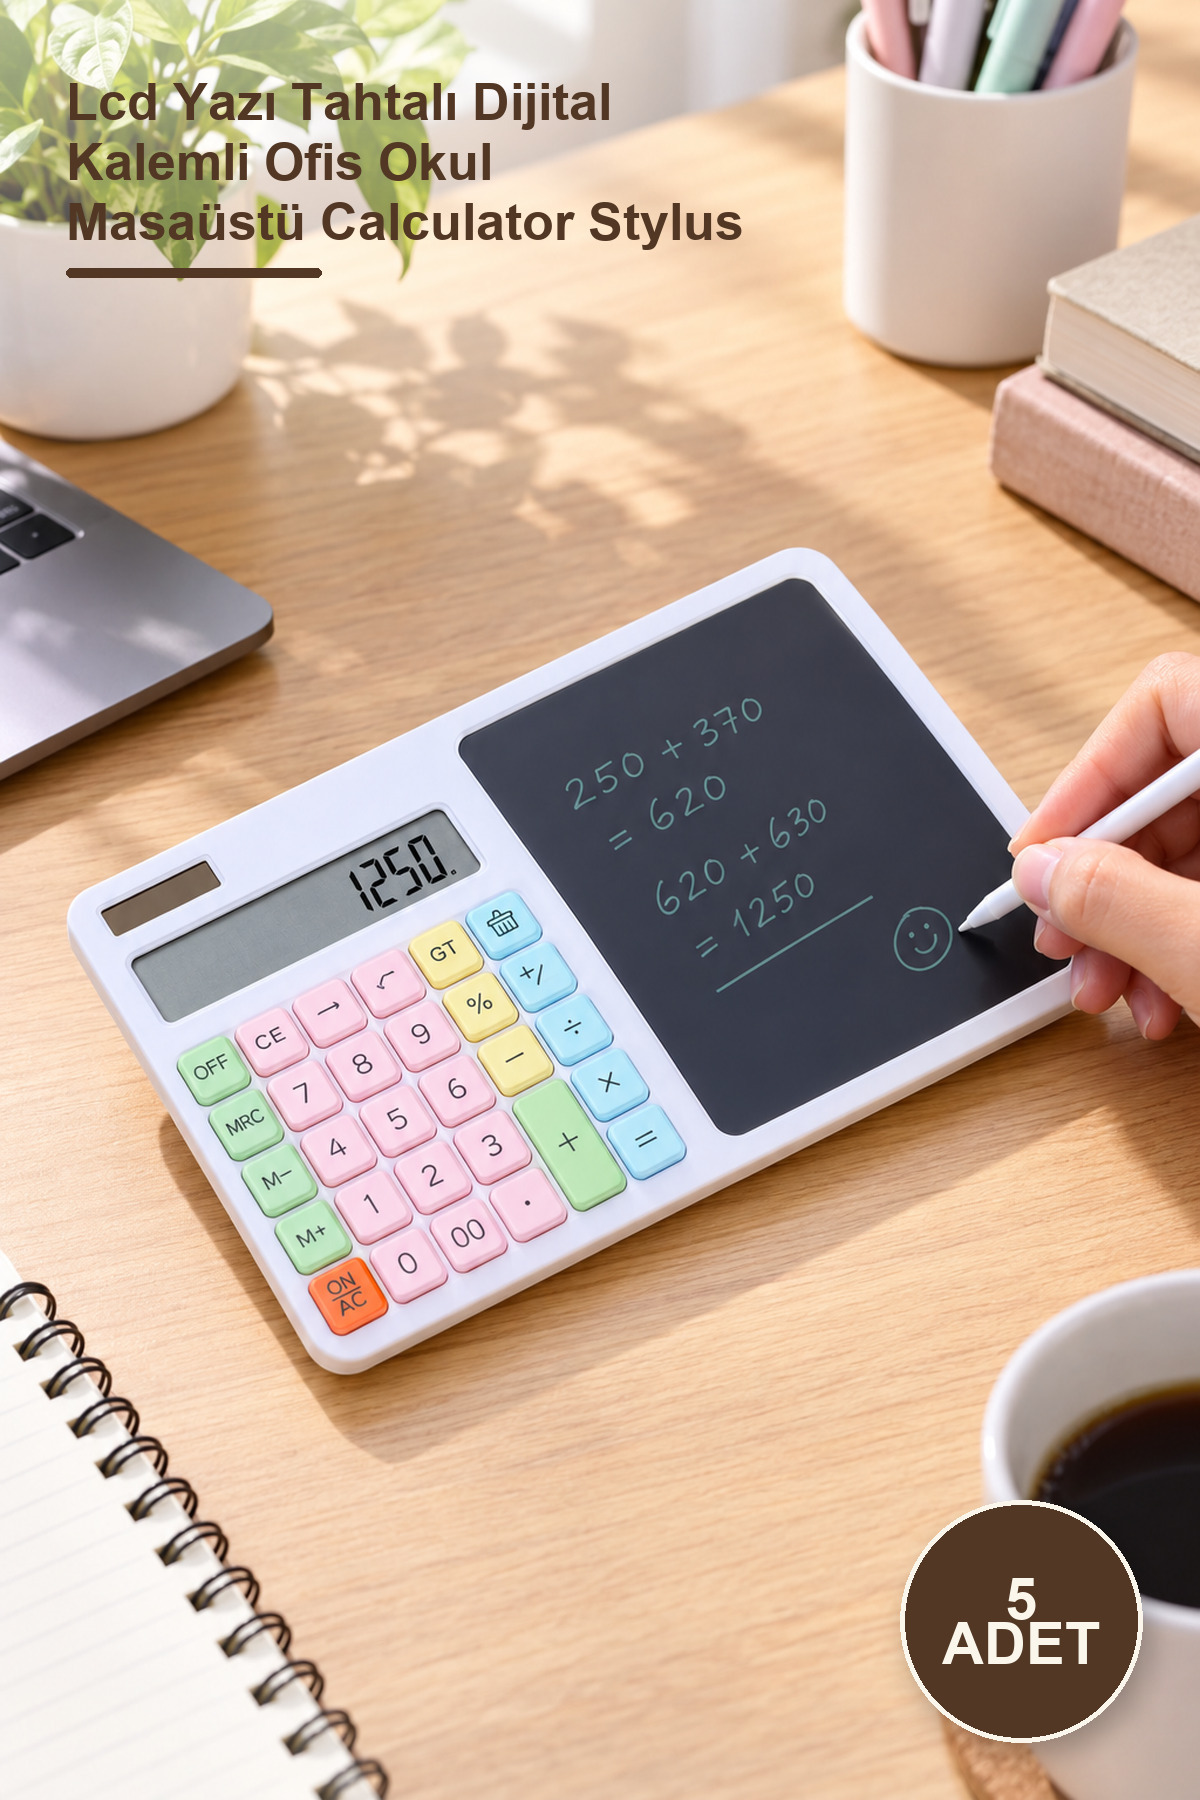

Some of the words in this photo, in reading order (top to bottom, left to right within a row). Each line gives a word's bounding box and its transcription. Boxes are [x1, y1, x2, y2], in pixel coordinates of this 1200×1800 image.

[566, 753, 643, 810] 250
[662, 740, 682, 758] +
[693, 698, 762, 746] 370
[609, 830, 632, 850] =
[650, 776, 725, 830] 620
[657, 859, 724, 915] 620
[741, 844, 759, 863] +
[770, 799, 826, 848] 630
[696, 936, 718, 957] =
[733, 873, 814, 936] 1250
[430, 940, 456, 961] GT
[467, 993, 493, 1014] %
[255, 1026, 286, 1049] CE
[411, 1024, 430, 1044] 9
[194, 1054, 227, 1080] OFF
[352, 1054, 373, 1074] 8
[293, 1082, 308, 1103] 7
[448, 1078, 467, 1099] 6
[225, 1109, 264, 1136] MRC
[387, 1108, 407, 1130] 5
[329, 1138, 347, 1157] 4
[481, 1135, 502, 1156] 3
[559, 1133, 578, 1151] +
[635, 1130, 657, 1147] =
[422, 1165, 444, 1187] 2
[364, 1194, 379, 1213] 1
[296, 1226, 325, 1248] M+
[451, 1219, 485, 1247] 00
[398, 1253, 417, 1274] 0
[326, 1271, 356, 1296] ON
[339, 1290, 367, 1316] AC
